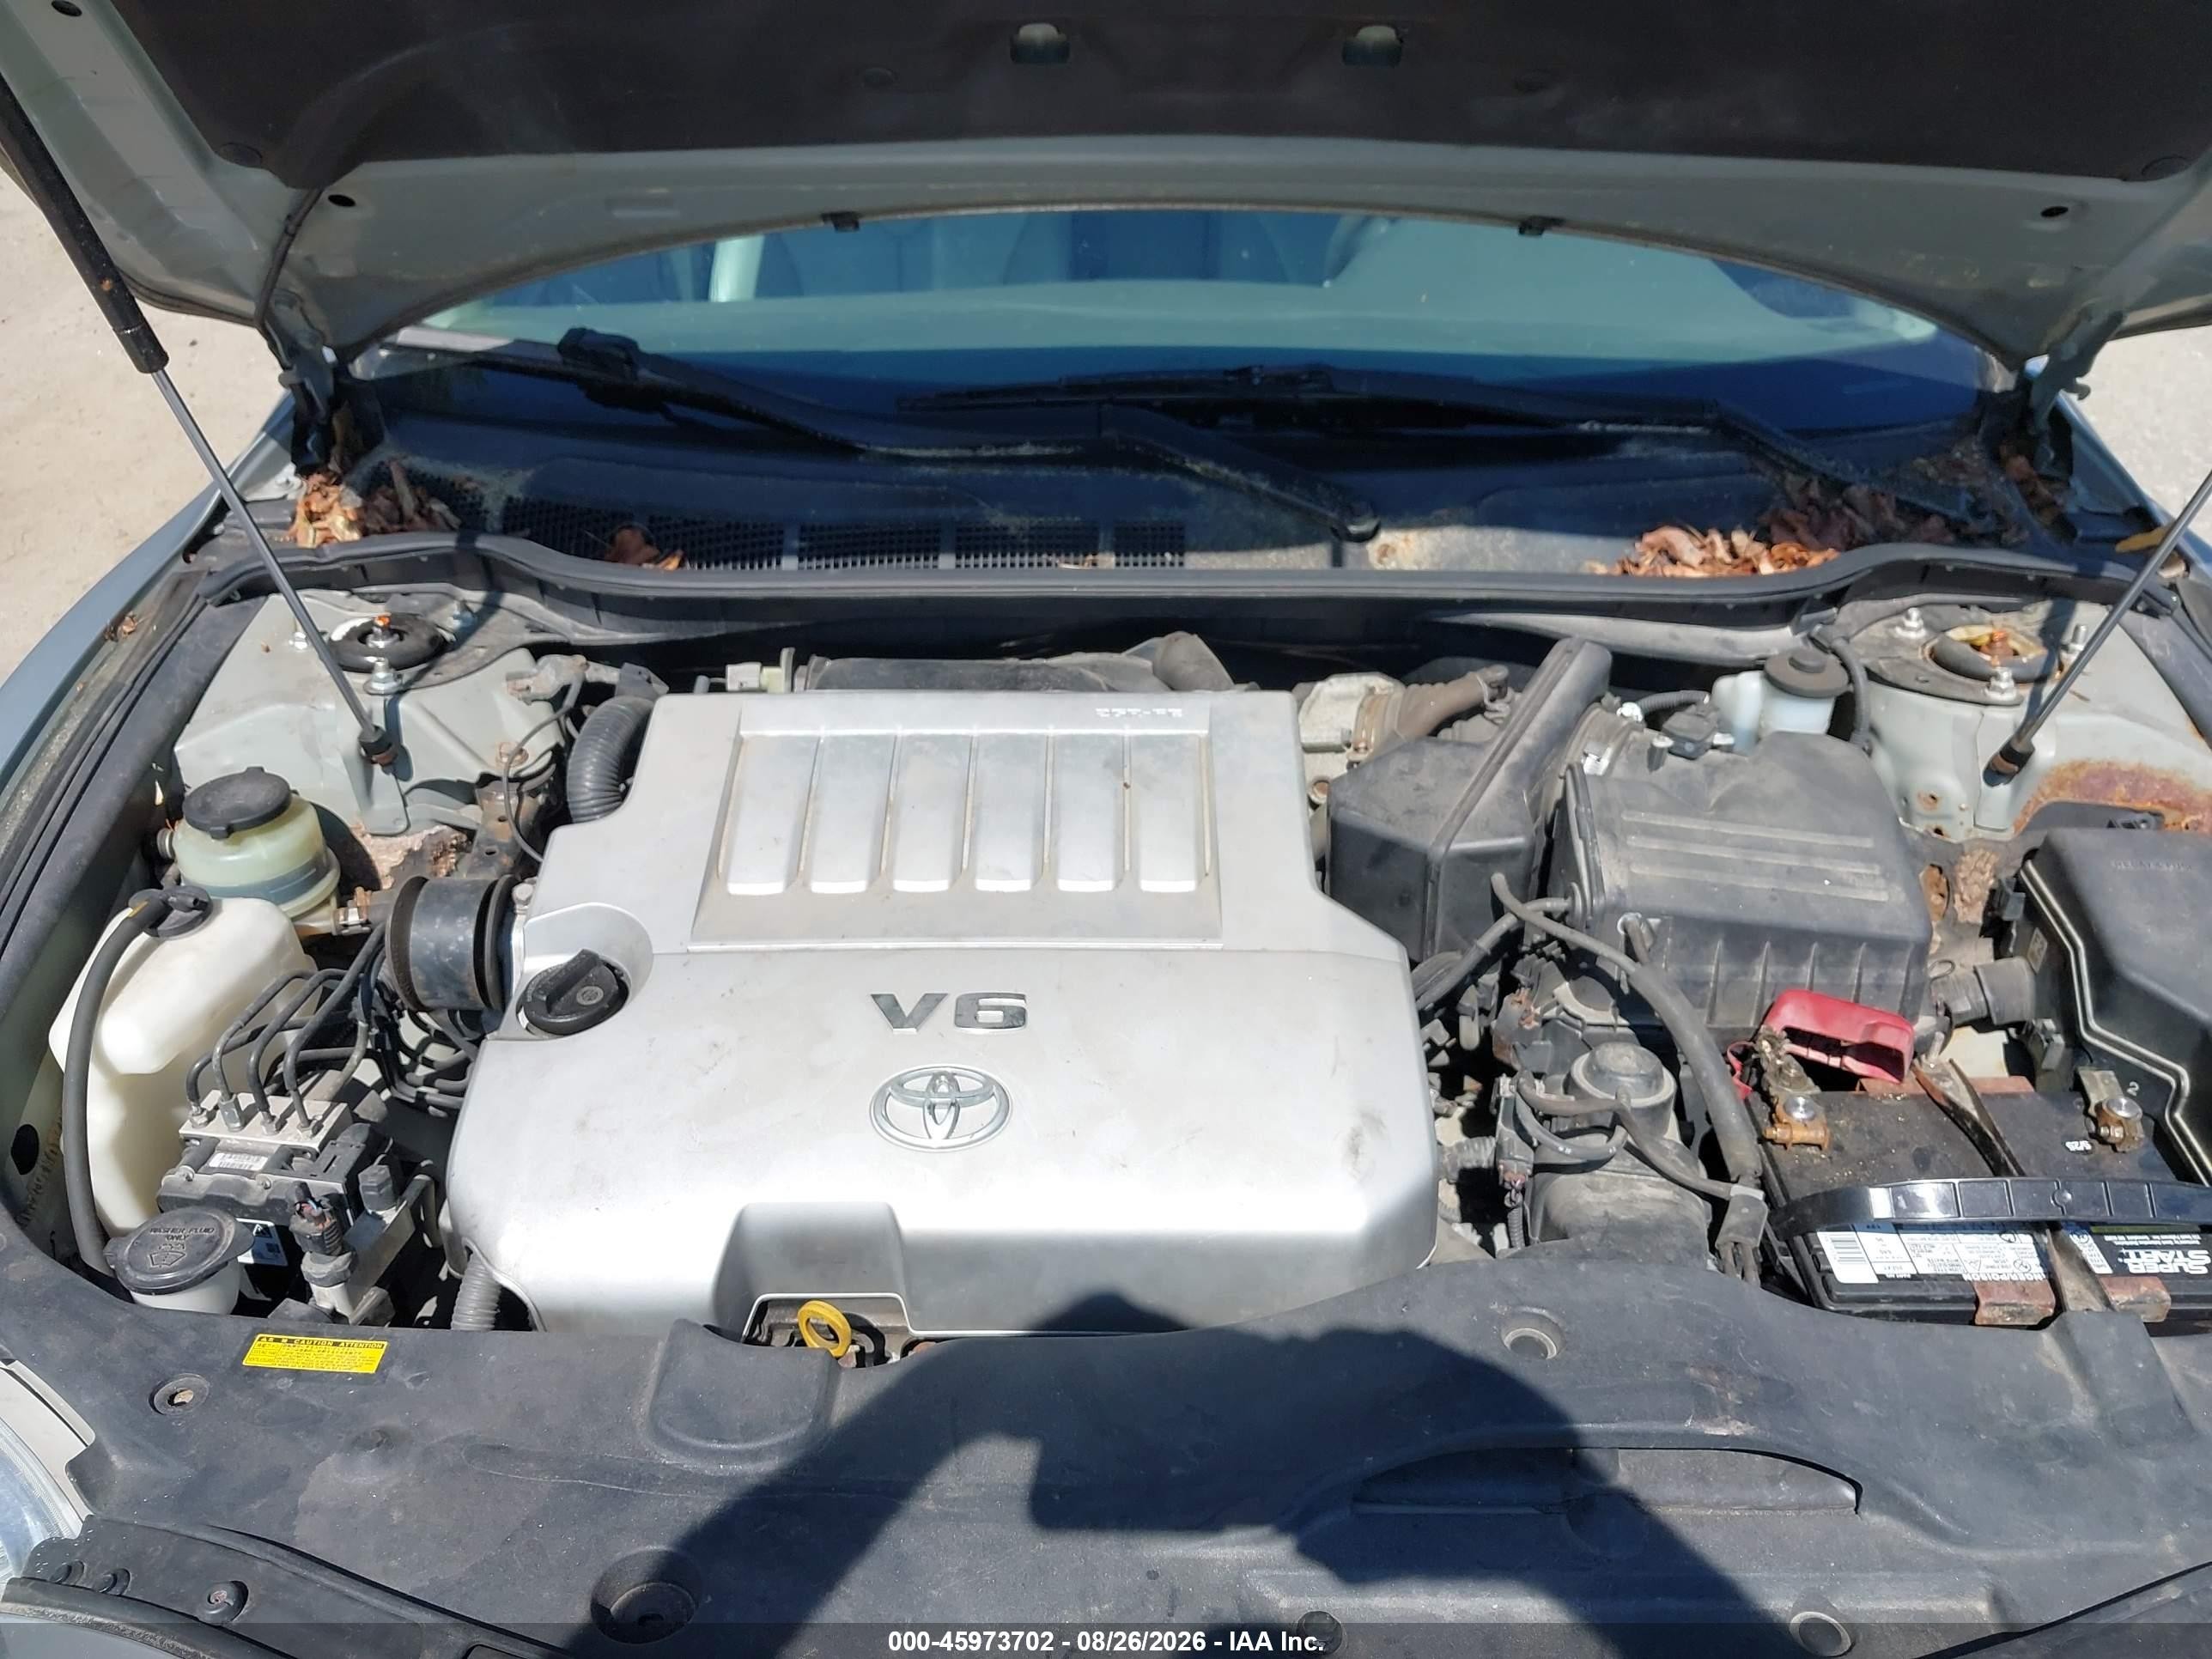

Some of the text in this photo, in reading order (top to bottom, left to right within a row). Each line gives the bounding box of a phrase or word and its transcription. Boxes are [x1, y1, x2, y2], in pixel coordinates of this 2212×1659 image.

[870, 992, 1027, 1035] V6
[2128, 1262, 2209, 1275] SUPER
[294, 1337, 334, 1346] CAUTION
[339, 1340, 383, 1349] ATTENTION
